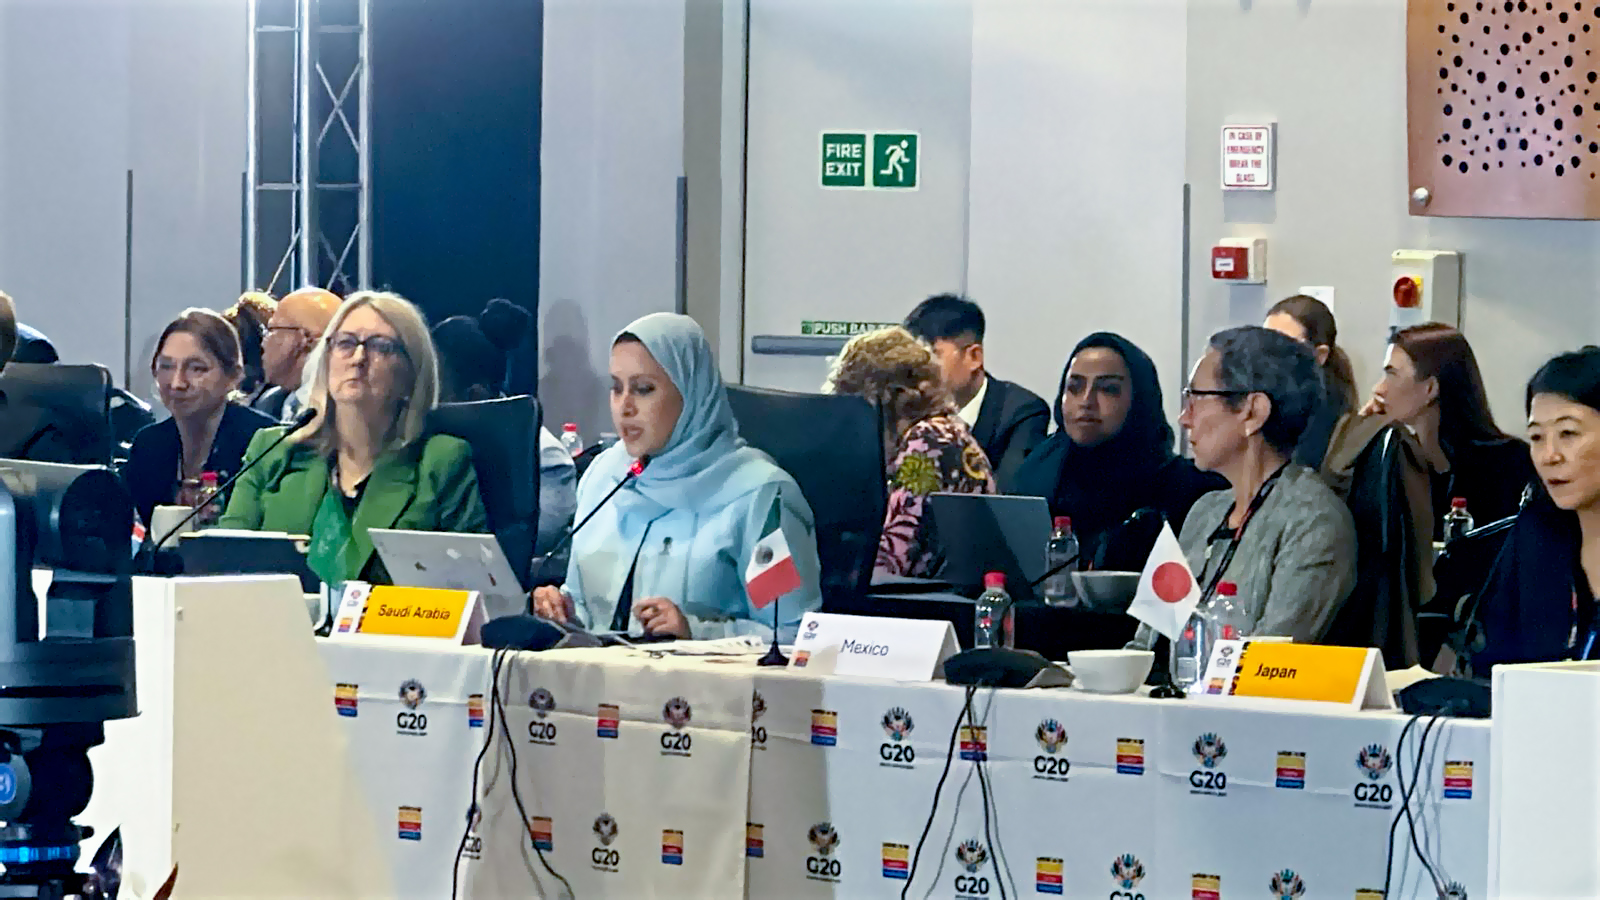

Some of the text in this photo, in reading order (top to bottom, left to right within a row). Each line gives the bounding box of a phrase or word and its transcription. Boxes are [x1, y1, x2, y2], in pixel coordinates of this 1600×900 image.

[826, 143, 863, 158] FIRE
[825, 161, 862, 177] EXIT
[815, 322, 847, 334] PUSH
[378, 603, 450, 620] Saudi Arabia
[840, 639, 889, 657] Mexico
[1254, 662, 1298, 680] Japan
[397, 712, 427, 730] G20
[528, 721, 557, 740] G20
[660, 732, 692, 751] G20
[880, 743, 915, 763] G20
[1034, 755, 1070, 776] G20
[1189, 770, 1227, 790] G20
[1354, 782, 1393, 803] G20
[591, 847, 620, 866] G20
[806, 856, 841, 877] G20
[954, 875, 990, 895] G20
